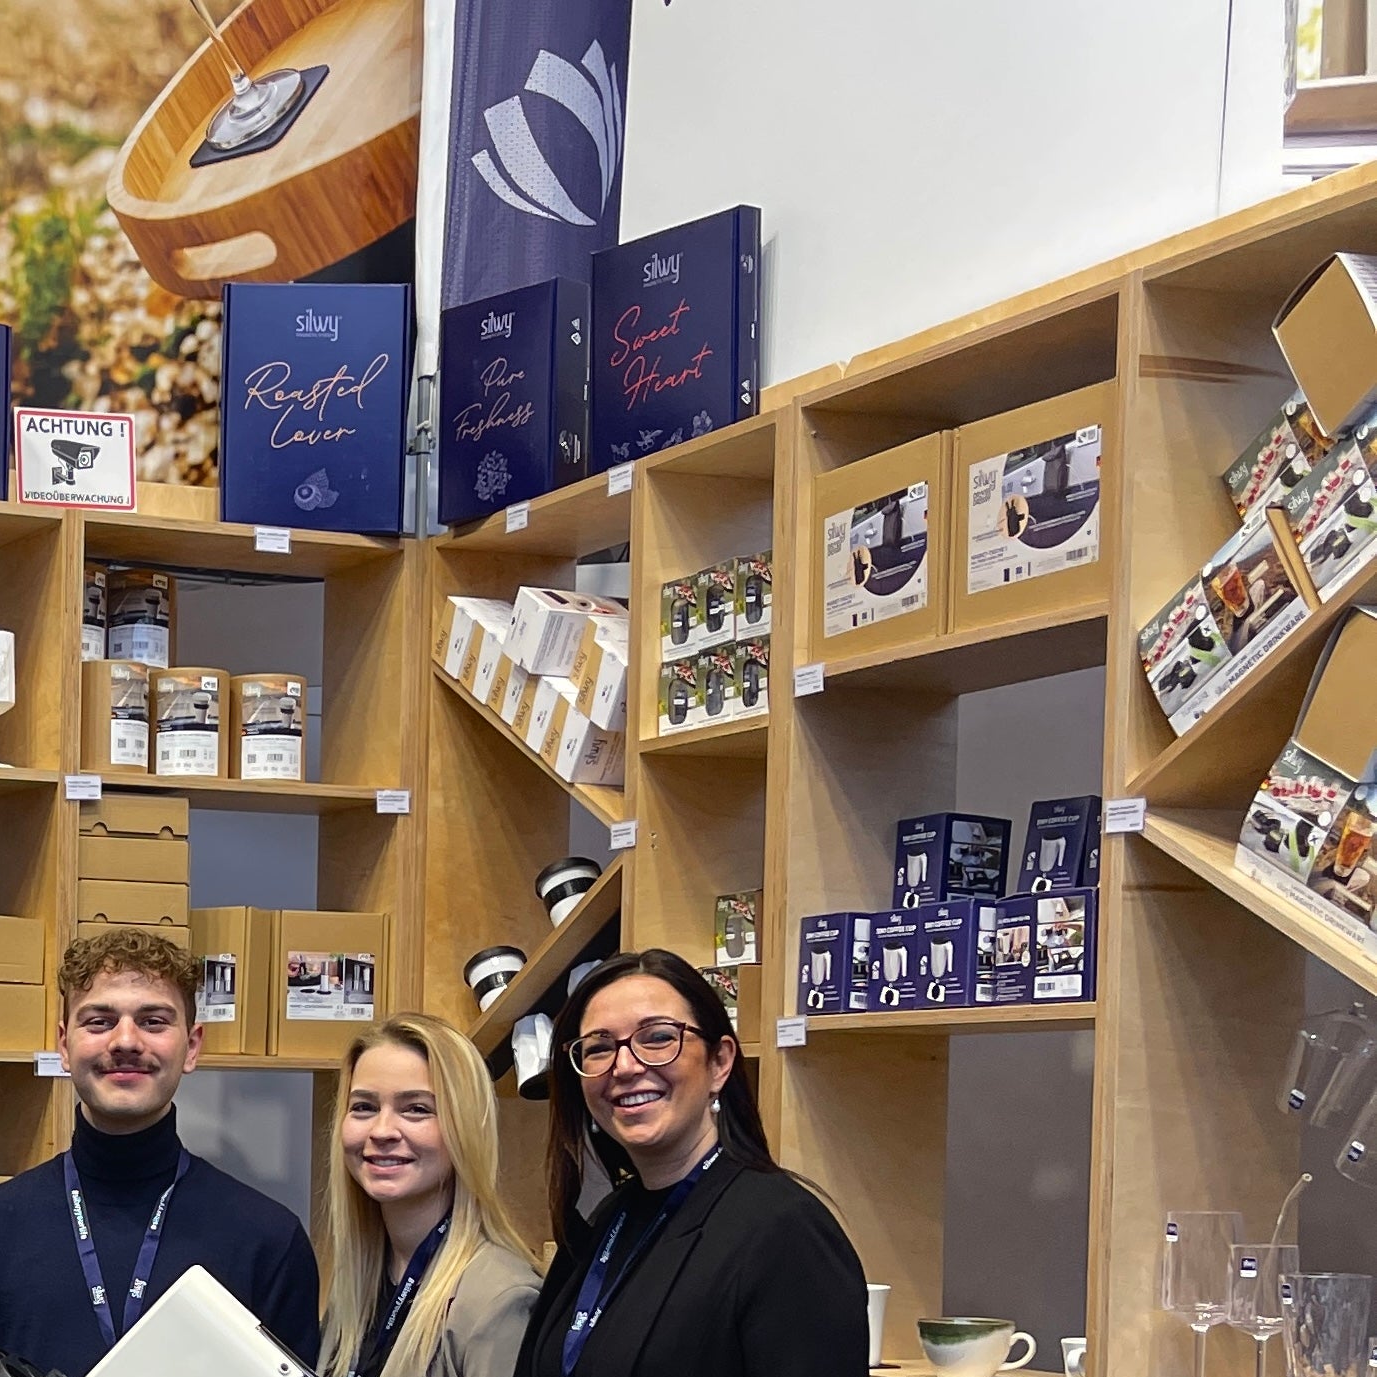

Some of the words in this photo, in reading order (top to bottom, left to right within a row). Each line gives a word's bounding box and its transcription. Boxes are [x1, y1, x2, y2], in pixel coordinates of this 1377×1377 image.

[643, 251, 683, 286] silwy
[295, 309, 342, 341] silwy
[481, 310, 515, 340] silwy
[610, 298, 690, 367] Sweet
[244, 353, 389, 421] Roasted
[480, 357, 525, 397] Pure
[624, 342, 713, 411] Heart
[26, 416, 110, 437] ACHTUNG
[270, 404, 358, 449] Lover
[451, 392, 535, 442] Freshness
[24, 490, 123, 505] VIDEOÜBERWACHUNG
[973, 469, 998, 493] silwy
[1228, 649, 1264, 685] MAGNETIC
[585, 738, 608, 765] silwy
